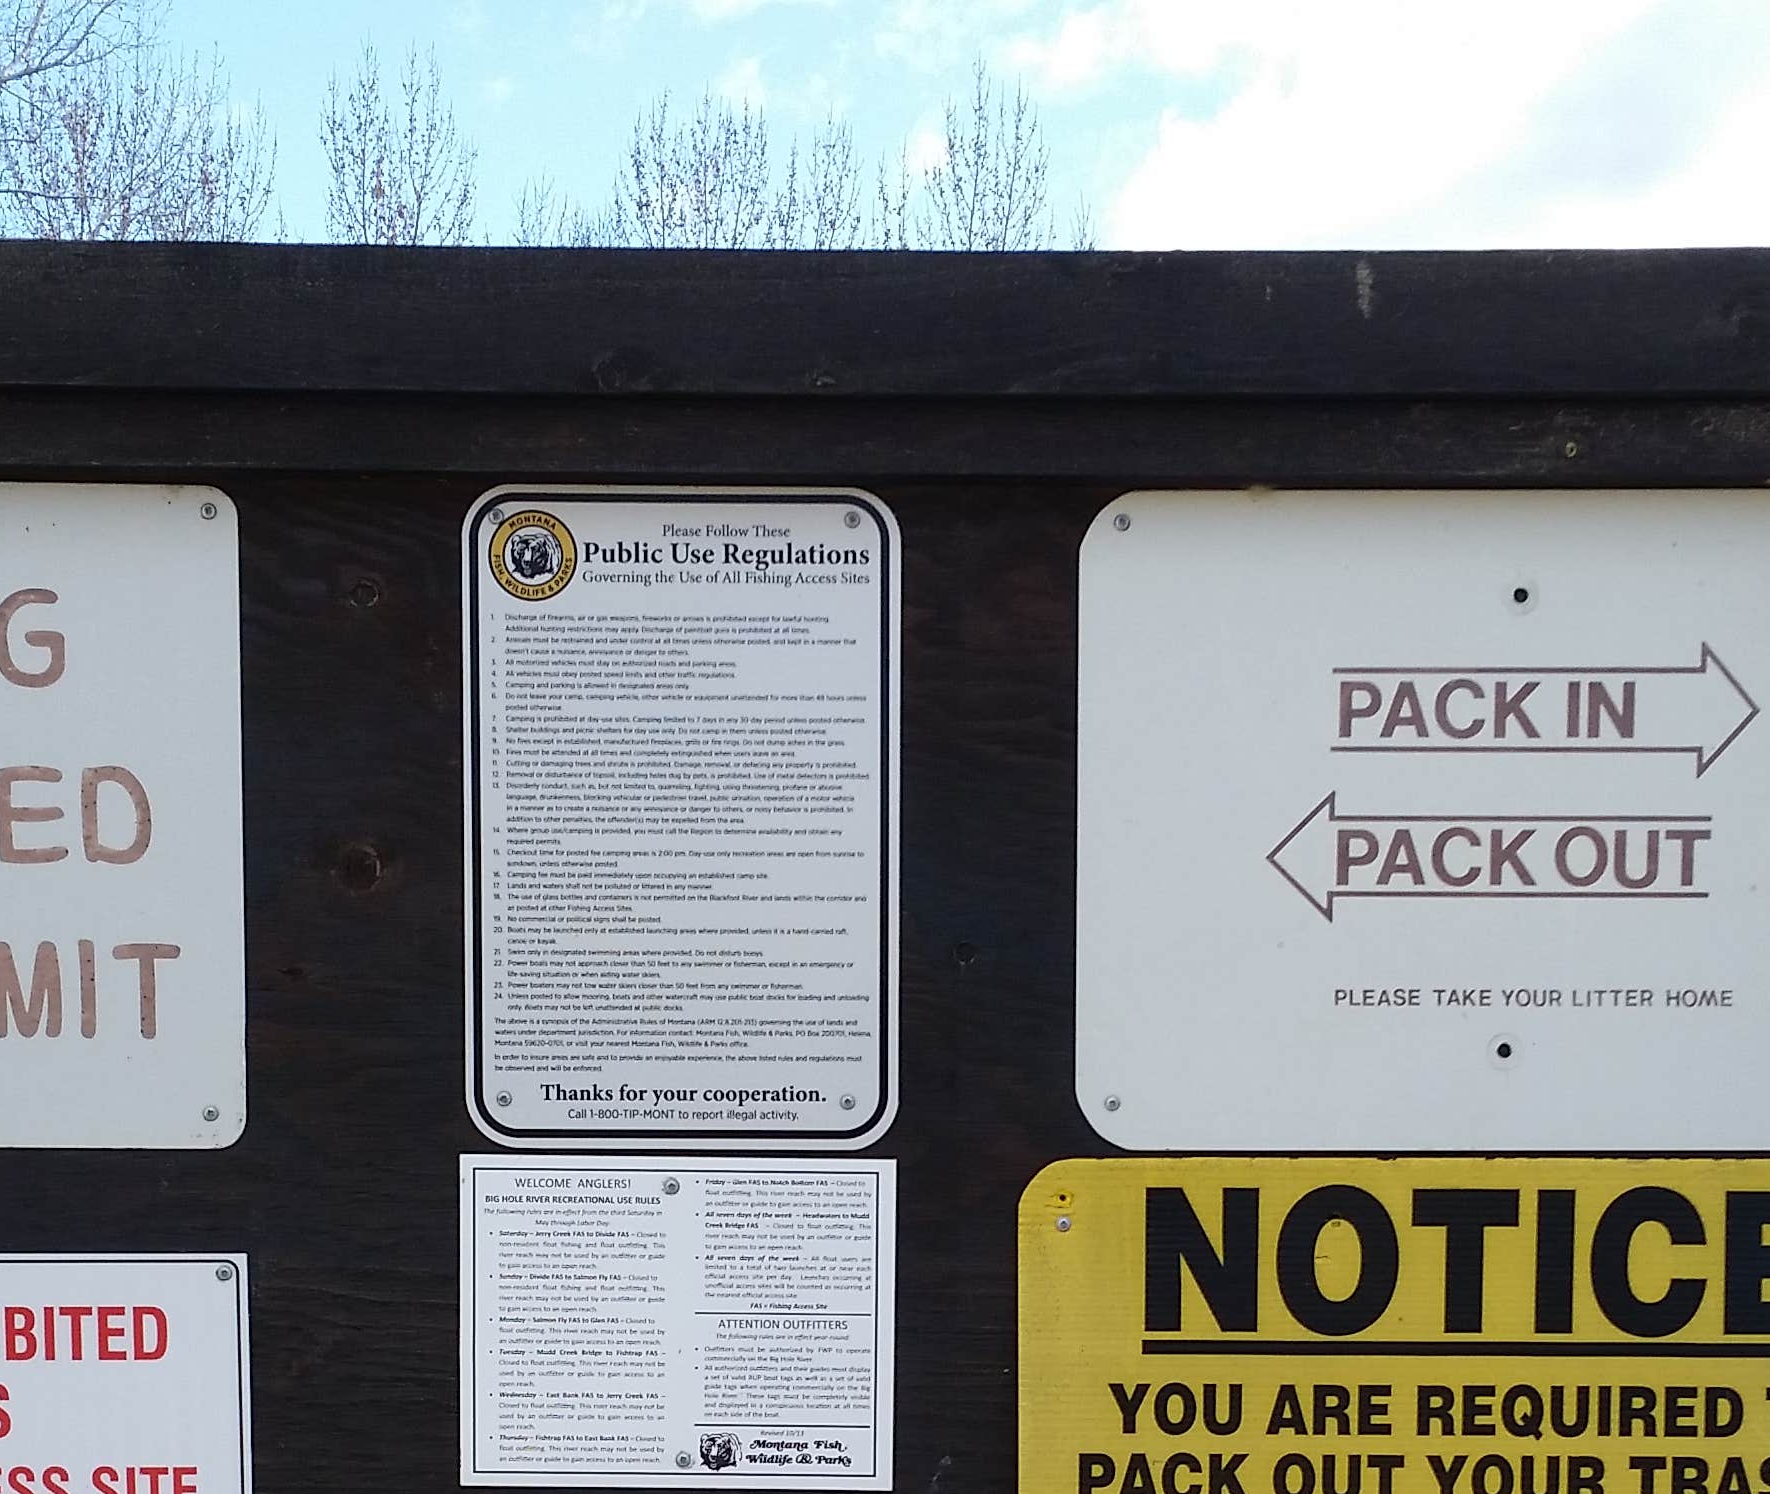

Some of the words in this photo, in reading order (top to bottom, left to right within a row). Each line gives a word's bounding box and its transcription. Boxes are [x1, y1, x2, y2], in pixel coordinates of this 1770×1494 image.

[661, 524, 703, 539] Please
[705, 523, 750, 538] Follow
[752, 524, 792, 538] These
[582, 541, 664, 566] Public
[670, 542, 717, 566] Use
[723, 541, 871, 573] Regulations
[582, 570, 652, 587] Governing
[655, 569, 674, 584] the
[679, 571, 702, 584] Use
[705, 570, 720, 584] of
[722, 570, 741, 584] All
[745, 569, 792, 587] Fishing
[794, 572, 837, 584] Access
[841, 572, 870, 584] Sites
[1338, 678, 1541, 740] PACK
[1566, 680, 1636, 739] IN
[1335, 826, 1537, 887] PACK
[1554, 825, 1712, 890] OUT
[1334, 988, 1421, 1007] PLEASE
[1432, 989, 1492, 1007] TAKE
[1501, 988, 1562, 1007] YOUR
[1572, 989, 1654, 1007] LITTER
[1666, 989, 1733, 1008] HOME
[539, 1083, 614, 1101] Thanks
[619, 1083, 648, 1102] for
[652, 1089, 698, 1107] your
[702, 1085, 827, 1107] cooperation.
[567, 1108, 587, 1119] Call
[589, 1108, 675, 1120] 1-800-TIP-MONT
[678, 1110, 689, 1120] to
[691, 1110, 723, 1121] report
[514, 1177, 572, 1189] WELCOME
[577, 1178, 631, 1189] ANGLERS!
[501, 1195, 524, 1203] HOLE
[525, 1195, 551, 1204] RIVER
[552, 1195, 615, 1204] RECREATIONAL
[717, 1318, 780, 1331] ATTENTION
[782, 1318, 849, 1332] OUTFITTERS
[1107, 1382, 1243, 1436] YOU
[1265, 1384, 1392, 1436] ARE
[1416, 1383, 1744, 1441] REQUIRED
